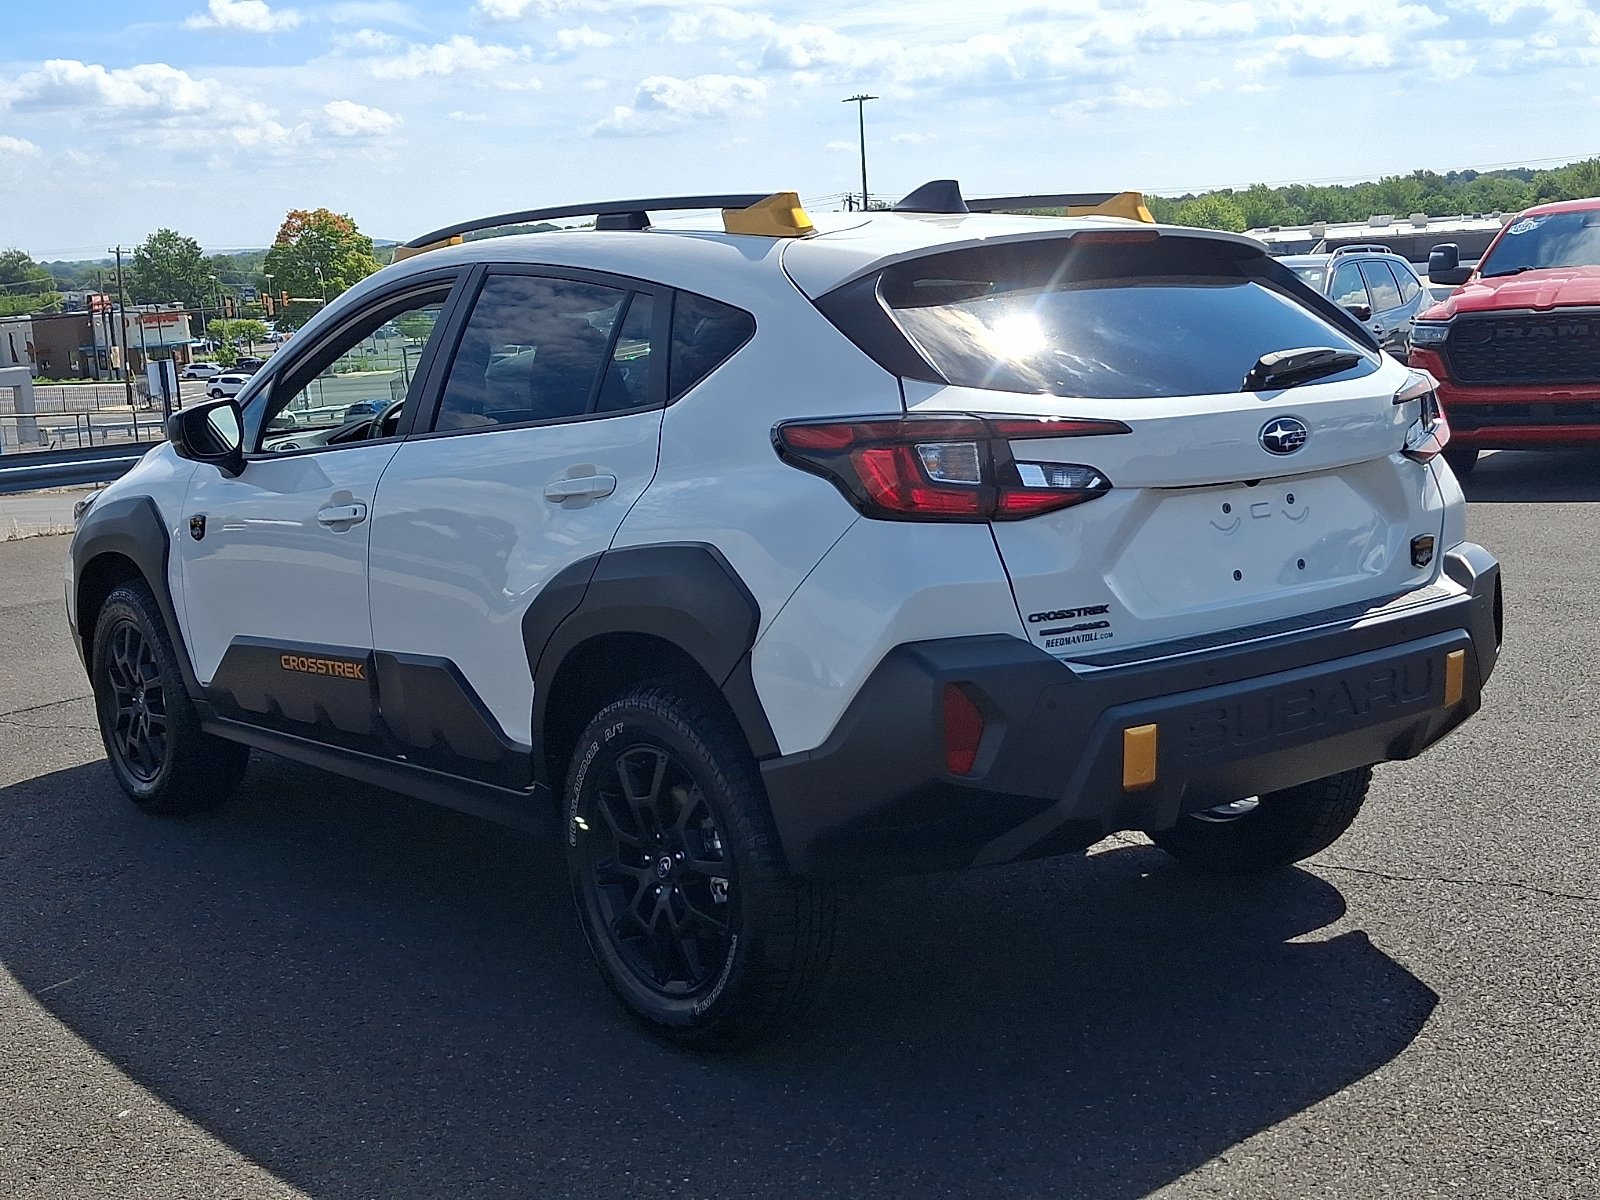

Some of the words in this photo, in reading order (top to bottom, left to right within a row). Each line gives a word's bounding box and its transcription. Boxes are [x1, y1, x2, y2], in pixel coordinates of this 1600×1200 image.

[1497, 325, 1589, 338] RAM
[1028, 604, 1110, 623] CROSSTREK
[281, 655, 365, 680] CROSSTREK
[1183, 657, 1433, 757] SUBARU
